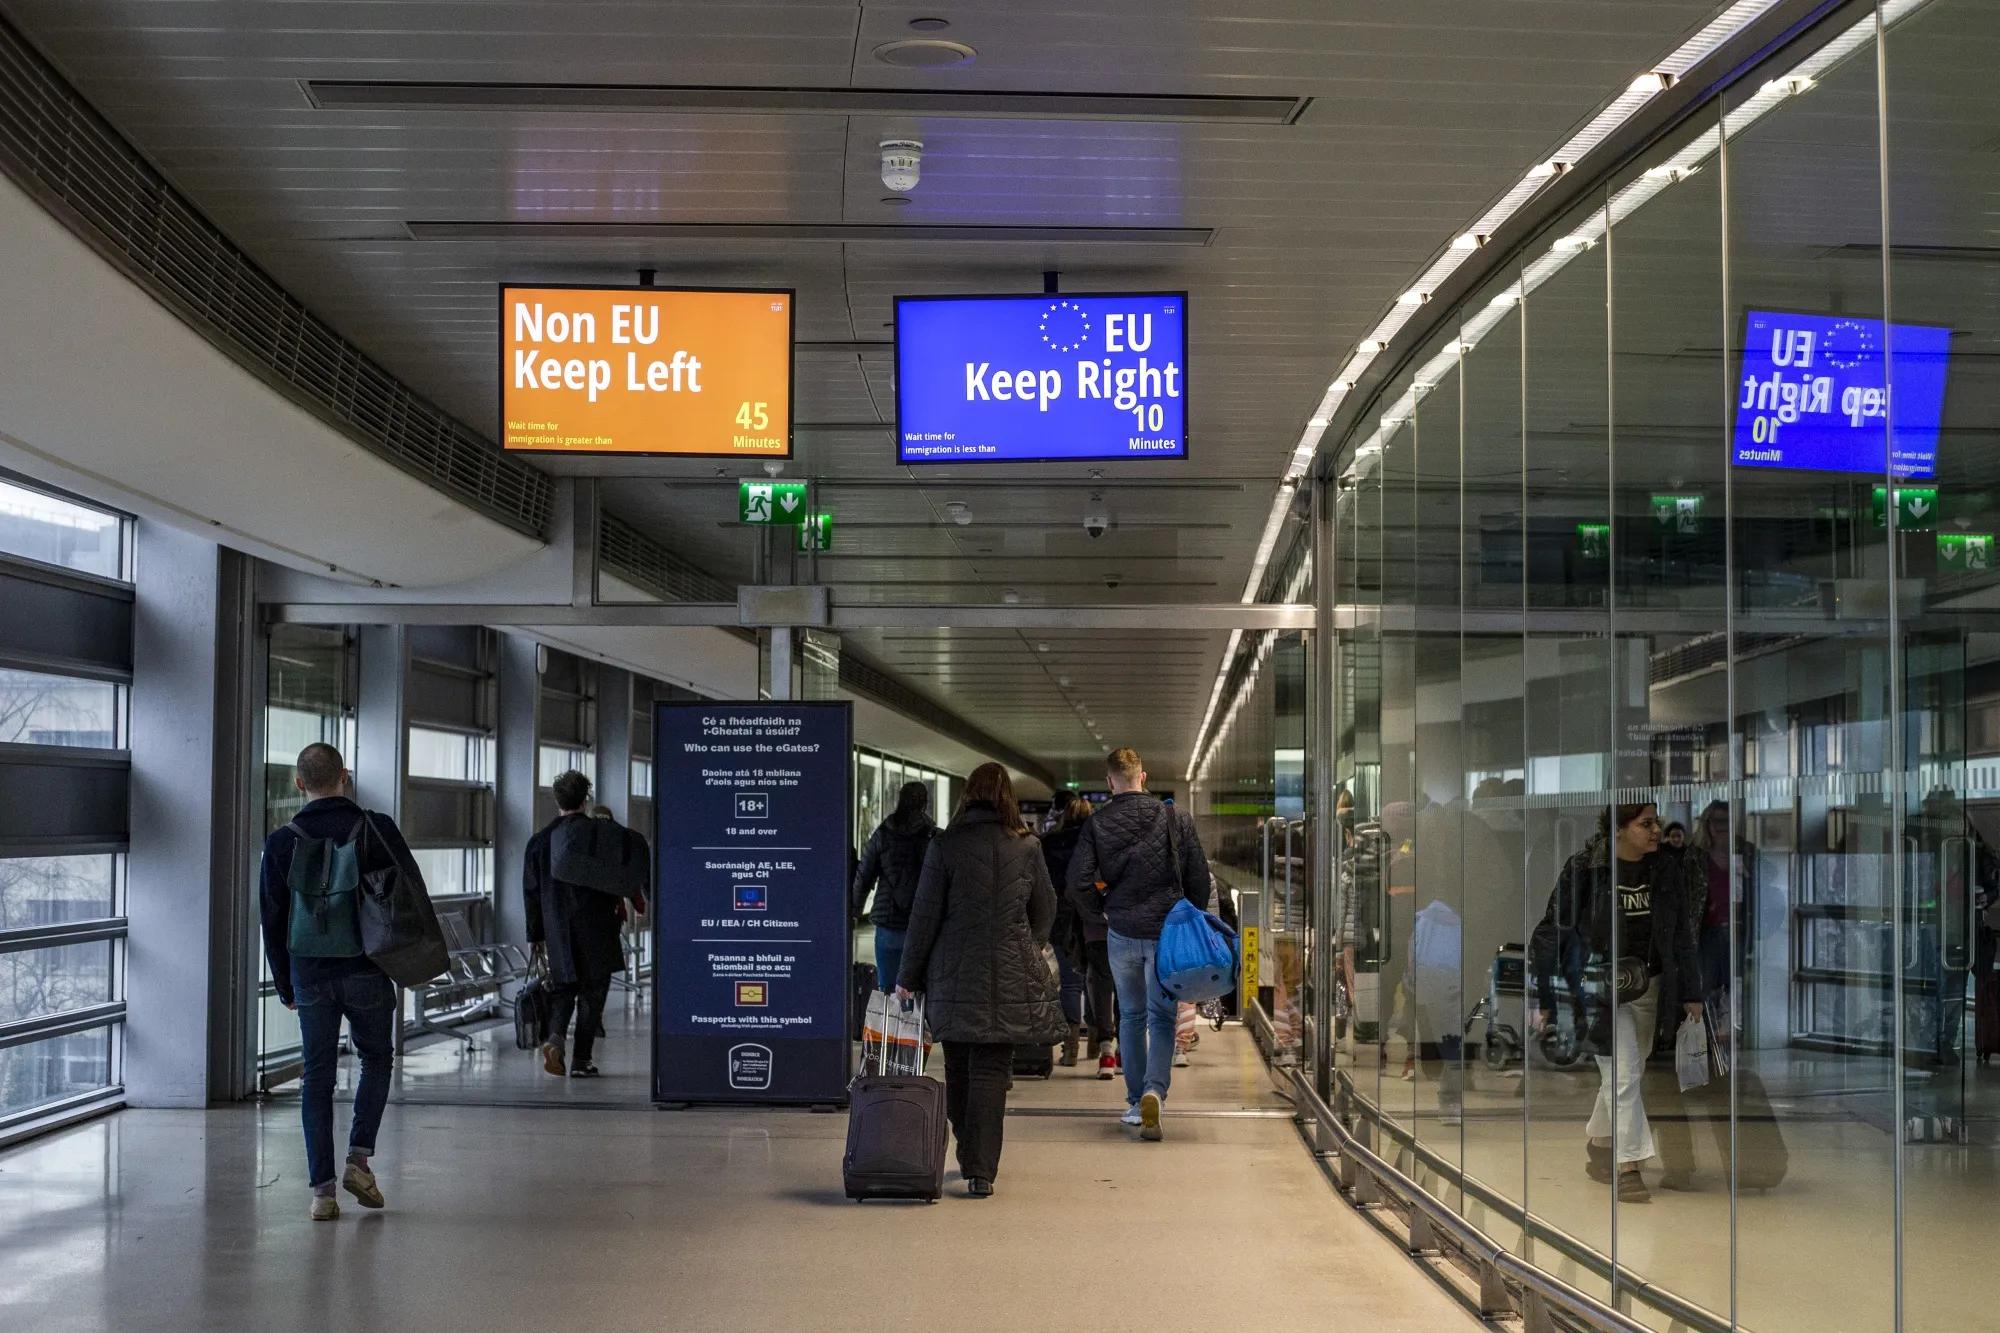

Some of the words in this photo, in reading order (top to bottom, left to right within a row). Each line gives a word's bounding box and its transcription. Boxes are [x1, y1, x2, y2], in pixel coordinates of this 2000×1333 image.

[515, 302, 595, 343] Non
[612, 304, 659, 344] EU
[1106, 314, 1152, 352] EU
[515, 350, 610, 402] Keep
[628, 350, 701, 392] Left
[966, 362, 1062, 412] Keep
[1078, 358, 1179, 410] Right
[736, 401, 768, 430] 45
[1132, 404, 1164, 432] 10
[508, 422, 526, 430] Wait
[528, 422, 545, 431] time
[547, 421, 558, 431] for
[508, 434, 555, 446] immigration
[557, 435, 563, 444] is
[566, 436, 593, 446] greater
[595, 436, 612, 445] than
[905, 432, 923, 441] Wait
[924, 432, 942, 441] time
[944, 432, 955, 440] for
[733, 436, 780, 448] Minutes
[1129, 438, 1176, 450] Minutes
[906, 444, 952, 455] immigration
[954, 445, 960, 453] is
[962, 444, 976, 453] less
[977, 444, 996, 453] than
[702, 717, 716, 725] Cé
[729, 717, 785, 725] fhéadfaidh
[684, 744, 708, 752] Who
[756, 744, 772, 752] the
[776, 744, 820, 753] eGates?
[702, 769, 733, 777] Daoine
[735, 769, 750, 777] atá
[753, 769, 763, 777] 18
[766, 769, 801, 777] mbliana
[735, 779, 755, 787] agus
[758, 778, 777, 786] níos
[780, 778, 798, 786] sine
[739, 801, 764, 811] 18+
[705, 862, 755, 870] Saoránaigh
[758, 862, 773, 870] AE,
[775, 862, 795, 870] LEE,
[732, 871, 753, 879] agus
[763, 920, 798, 928] Citizens
[708, 954, 746, 962] Pasanna
[757, 954, 781, 962] bhfuil
[712, 963, 754, 971] tsiombail
[692, 1016, 736, 1024] Passports
[780, 1016, 812, 1025] symbol
